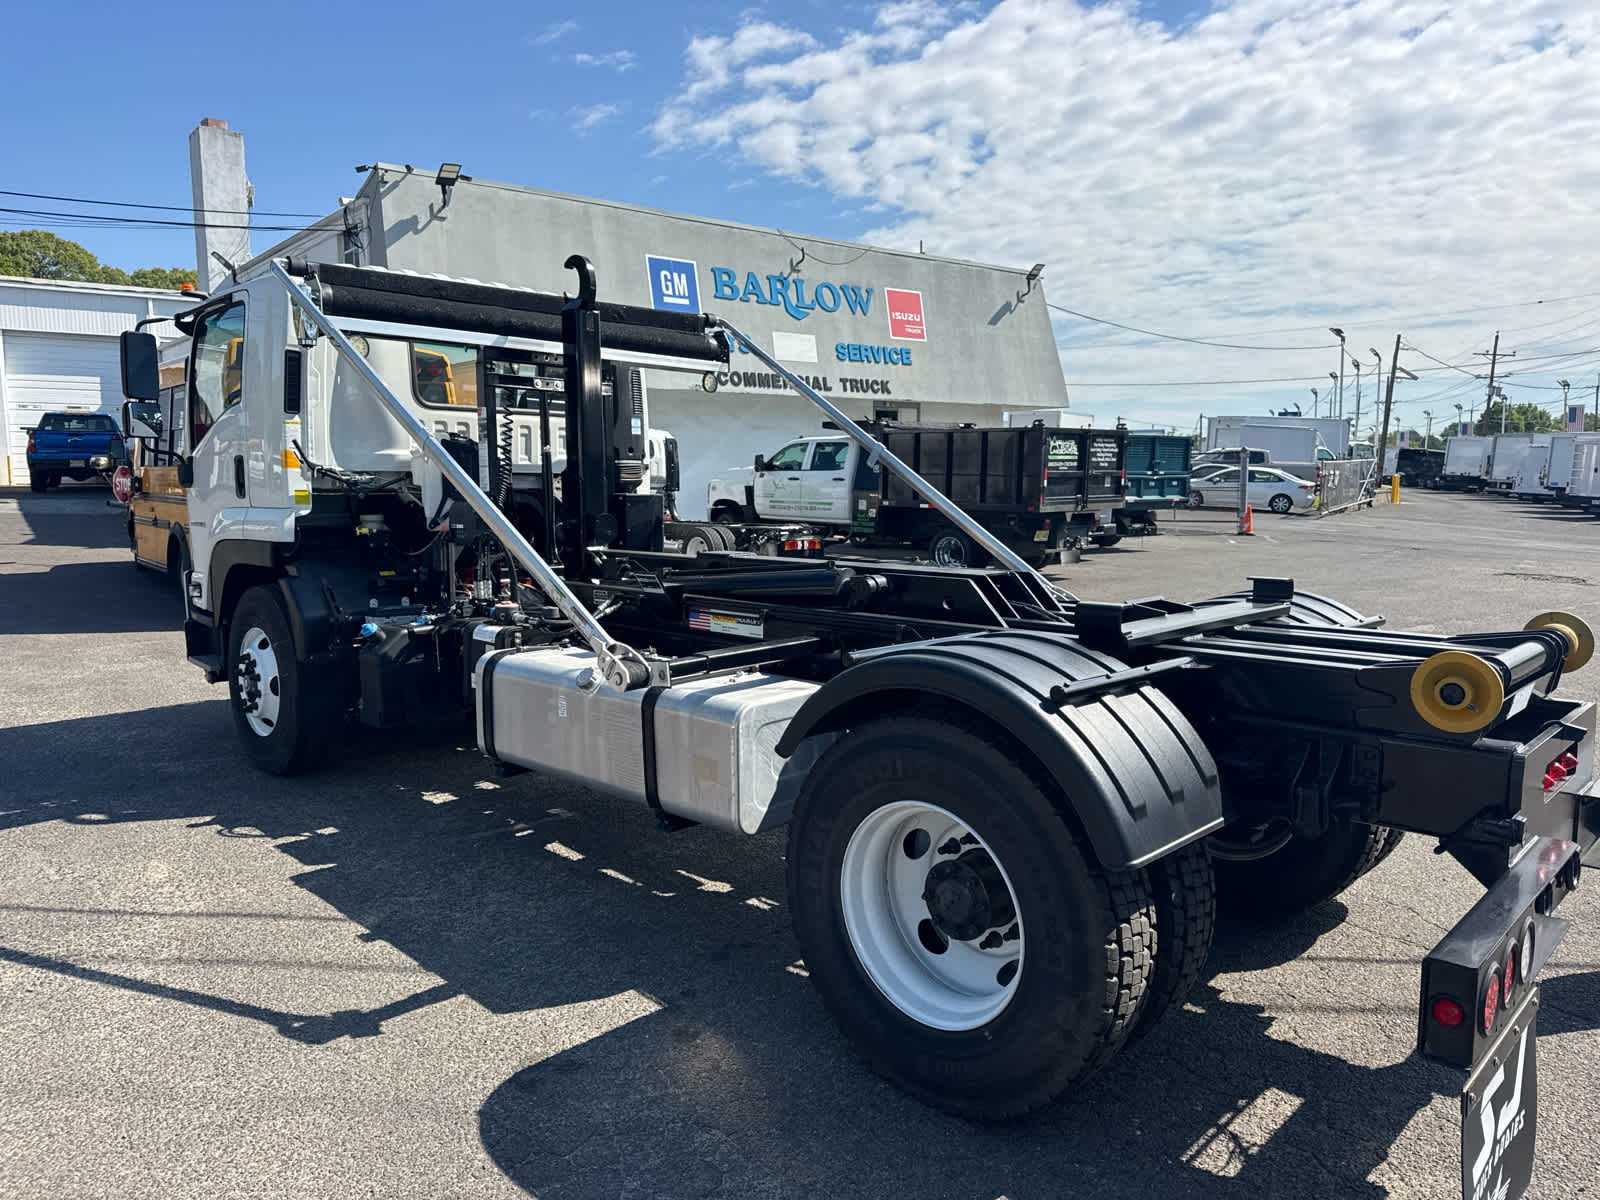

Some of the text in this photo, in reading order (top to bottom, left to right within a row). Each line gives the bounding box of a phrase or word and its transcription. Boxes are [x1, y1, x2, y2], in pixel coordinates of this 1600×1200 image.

[660, 270, 688, 297] GM
[711, 266, 874, 320] BARLOW
[892, 312, 921, 322] ISUZU
[835, 343, 912, 366] SERVICE
[717, 371, 892, 394] COMMEIAL TRUCK
